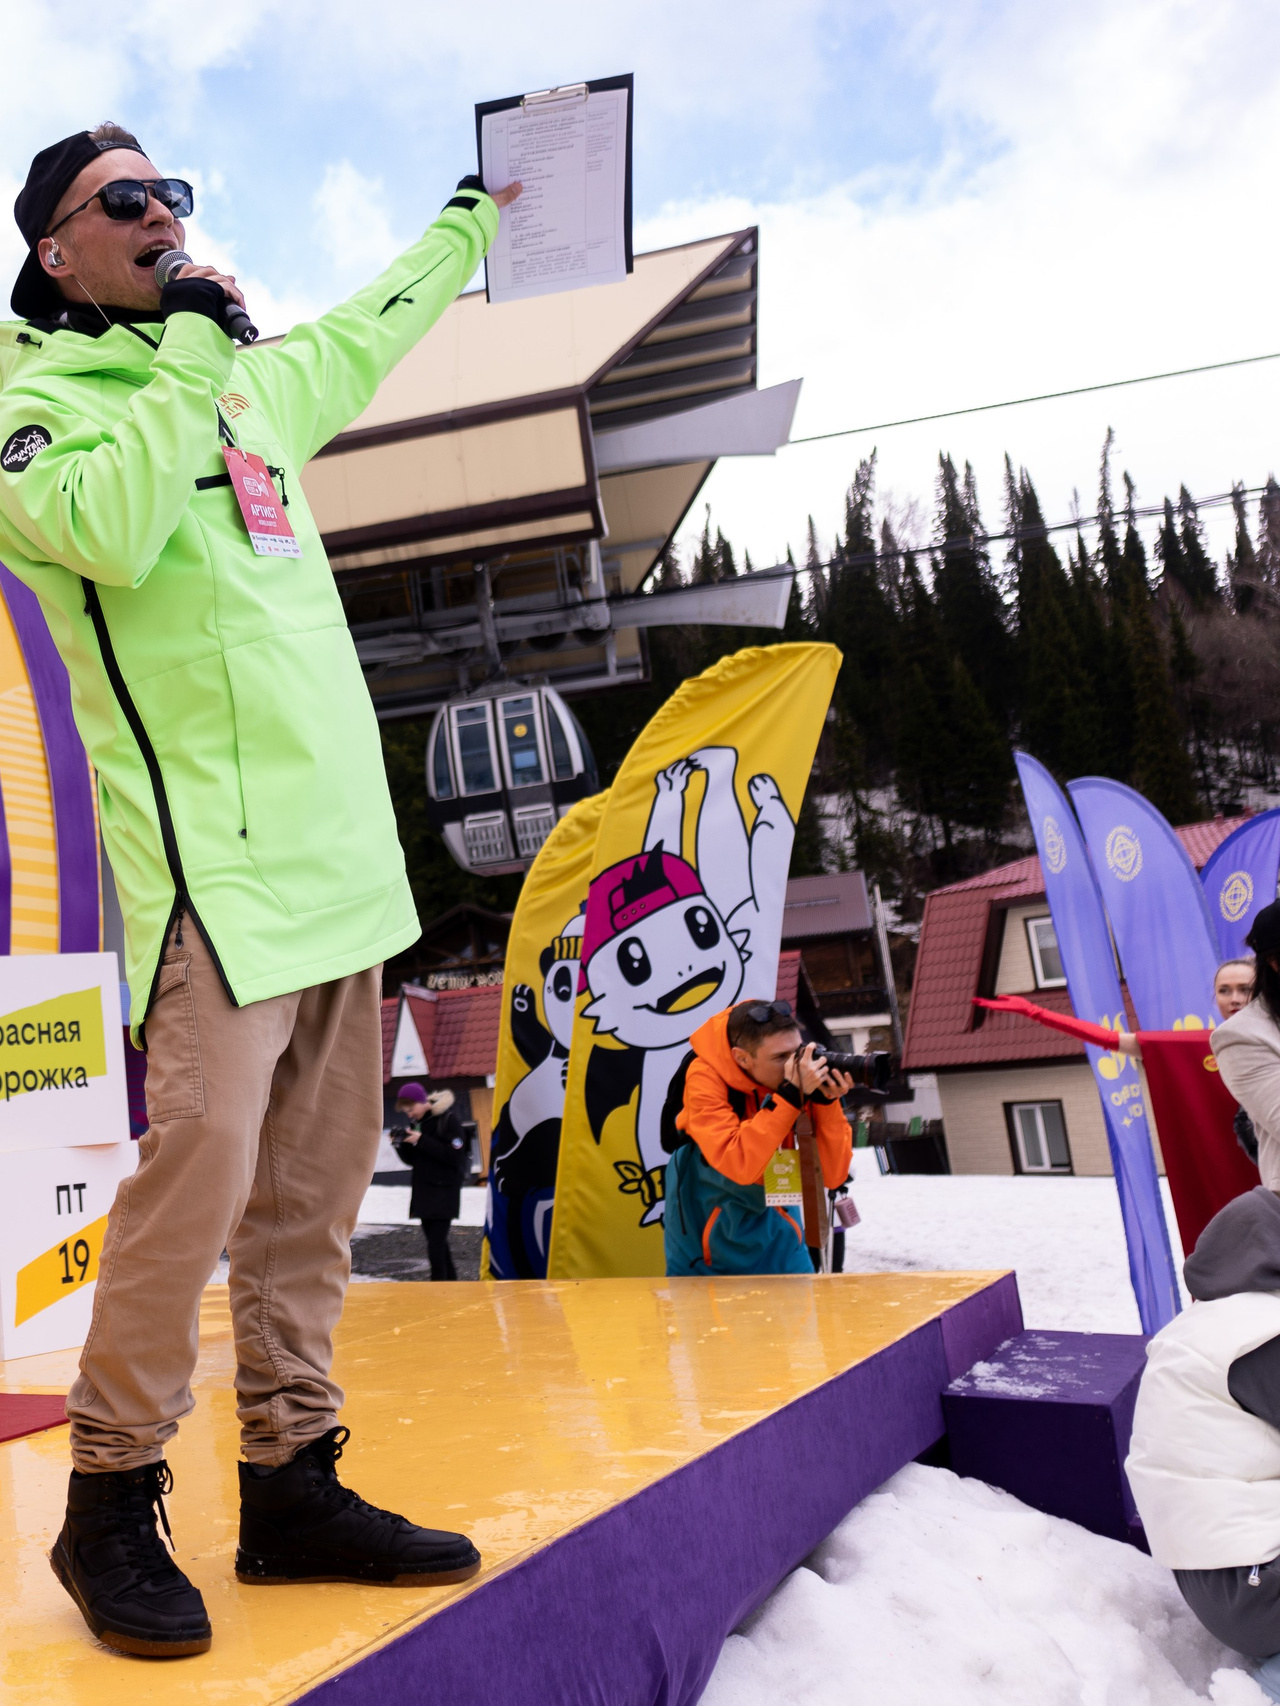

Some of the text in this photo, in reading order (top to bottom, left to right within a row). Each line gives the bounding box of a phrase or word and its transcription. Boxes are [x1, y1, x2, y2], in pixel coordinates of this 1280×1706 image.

[3, 436, 47, 466] MOUNTAIN
[250, 504, 278, 519] АРТИСТ
[56, 1183, 87, 1215] ПТ
[58, 1239, 90, 1285] 19
